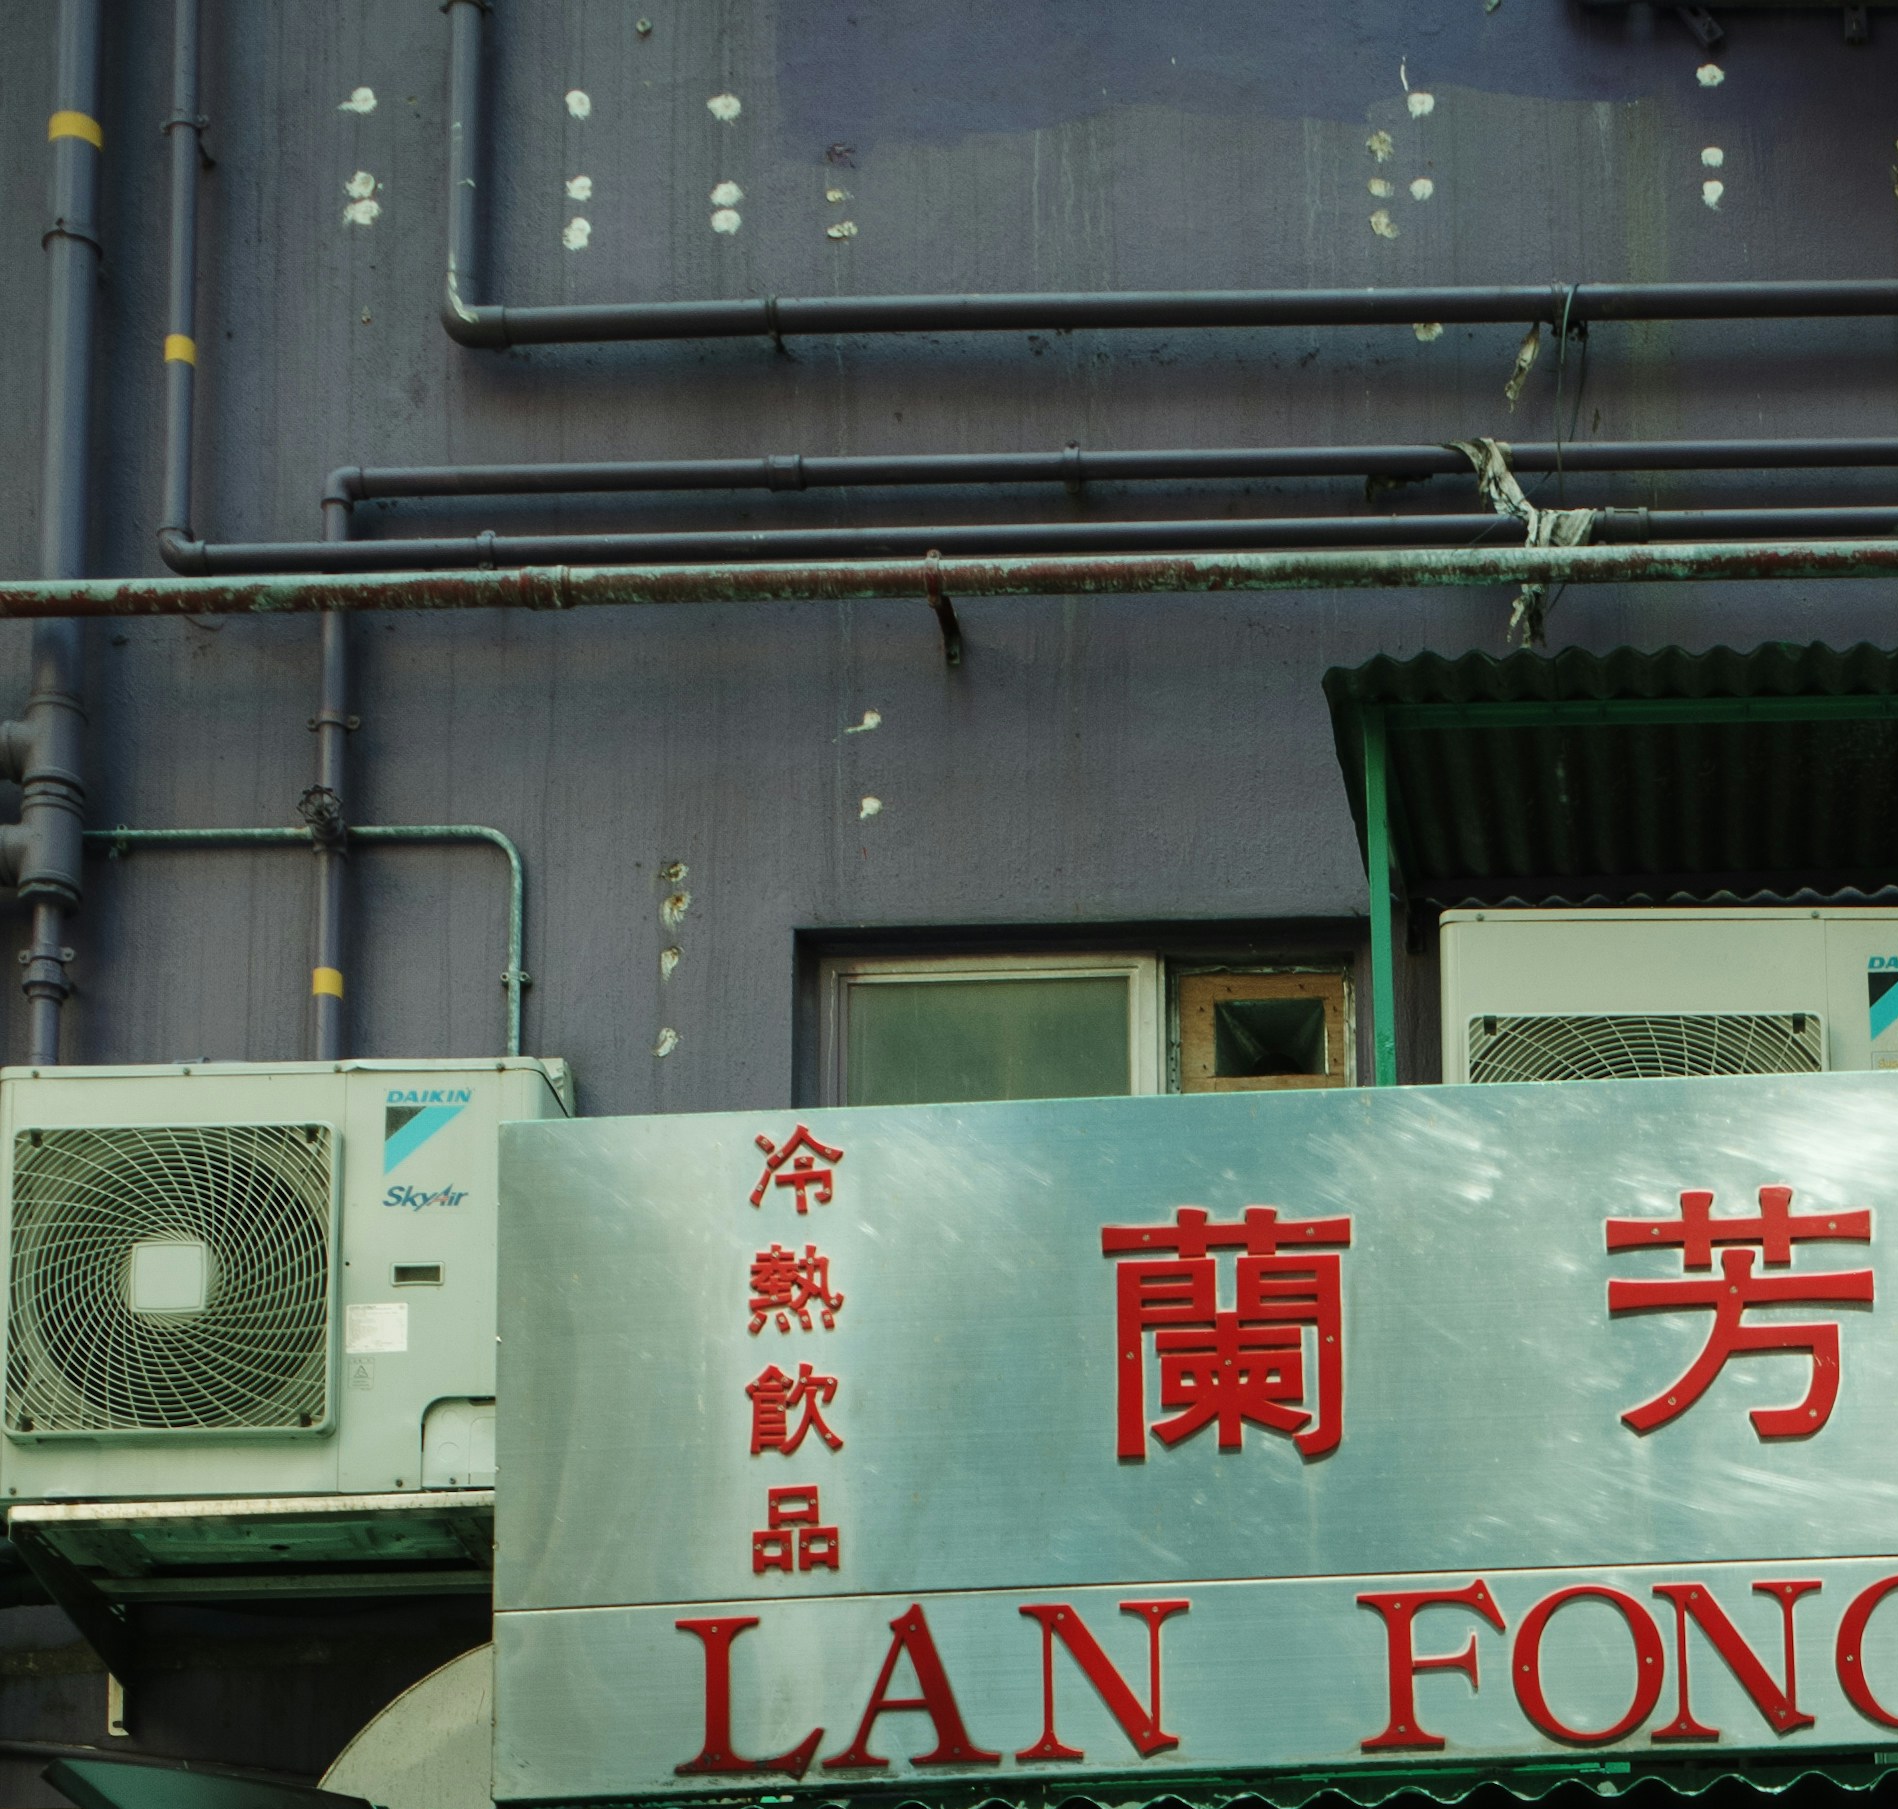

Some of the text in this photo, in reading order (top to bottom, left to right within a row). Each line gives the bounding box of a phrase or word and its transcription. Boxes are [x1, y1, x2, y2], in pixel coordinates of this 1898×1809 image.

[386, 1089, 472, 1103] DAIKIN
[746, 1125, 844, 1576] 冷熱飲品
[675, 1602, 1188, 1776] LAN
